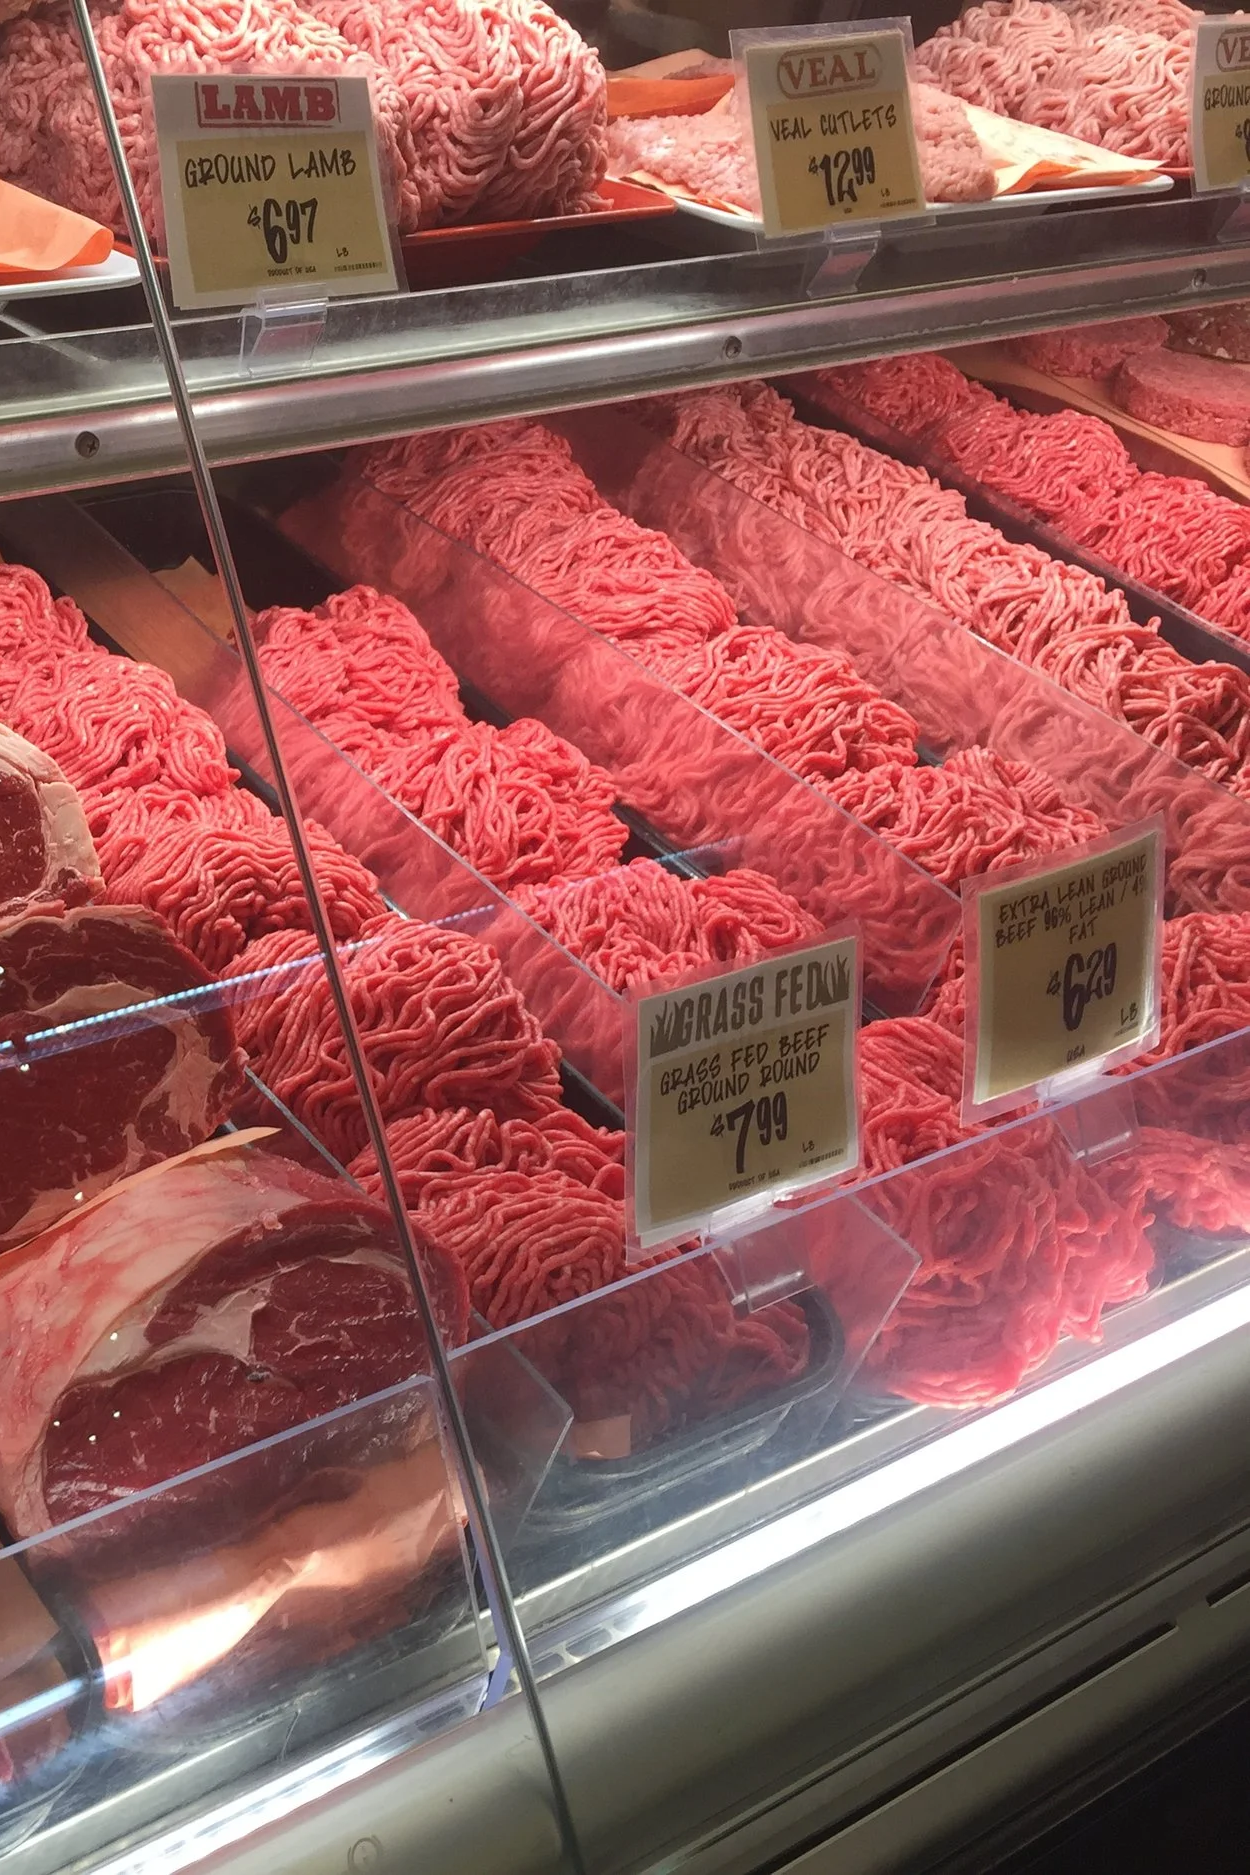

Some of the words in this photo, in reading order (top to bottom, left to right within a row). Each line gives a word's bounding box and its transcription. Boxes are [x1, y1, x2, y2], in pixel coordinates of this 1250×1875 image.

[780, 50, 876, 90] VEAL
[202, 84, 337, 122] LAMB
[770, 116, 813, 141] VEAL
[820, 104, 897, 136] CUTLETS
[185, 153, 276, 188] GROUND
[288, 148, 356, 179] LAMB
[335, 246, 349, 258] LB
[995, 916, 1038, 949] BEEF
[1079, 888, 1115, 919] LEAN
[998, 891, 1050, 925] EXTRA
[1057, 874, 1095, 905] LEAN
[1069, 916, 1098, 945] FAT
[677, 976, 764, 1048] GRASS
[775, 961, 824, 1018] FED
[1121, 1002, 1138, 1026] LB
[660, 1051, 721, 1097] GRASS
[731, 1042, 768, 1073] FED
[779, 1023, 830, 1058] BEEF
[677, 1072, 749, 1116] GROUND
[759, 1052, 820, 1089] ROUND
[802, 1140, 815, 1153] LB
